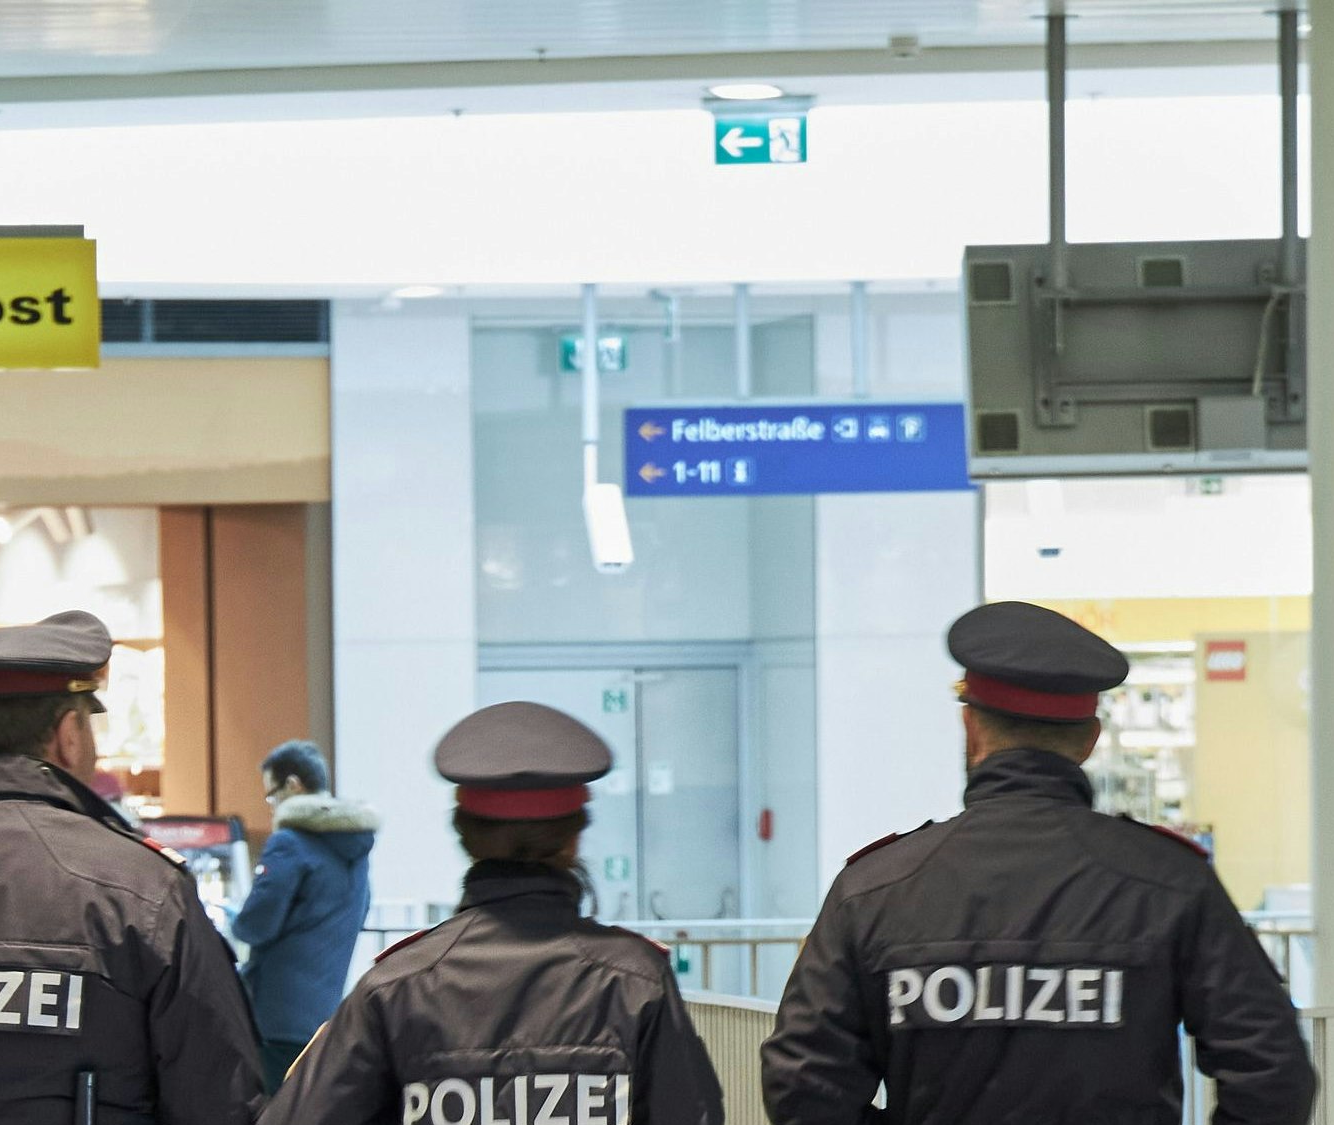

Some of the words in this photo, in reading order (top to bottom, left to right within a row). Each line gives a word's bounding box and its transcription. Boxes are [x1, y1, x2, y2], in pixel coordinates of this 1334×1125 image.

[670, 415, 826, 443] Felberstraße
[672, 460, 722, 484] 1-11
[888, 965, 1124, 1025] POLIZEI
